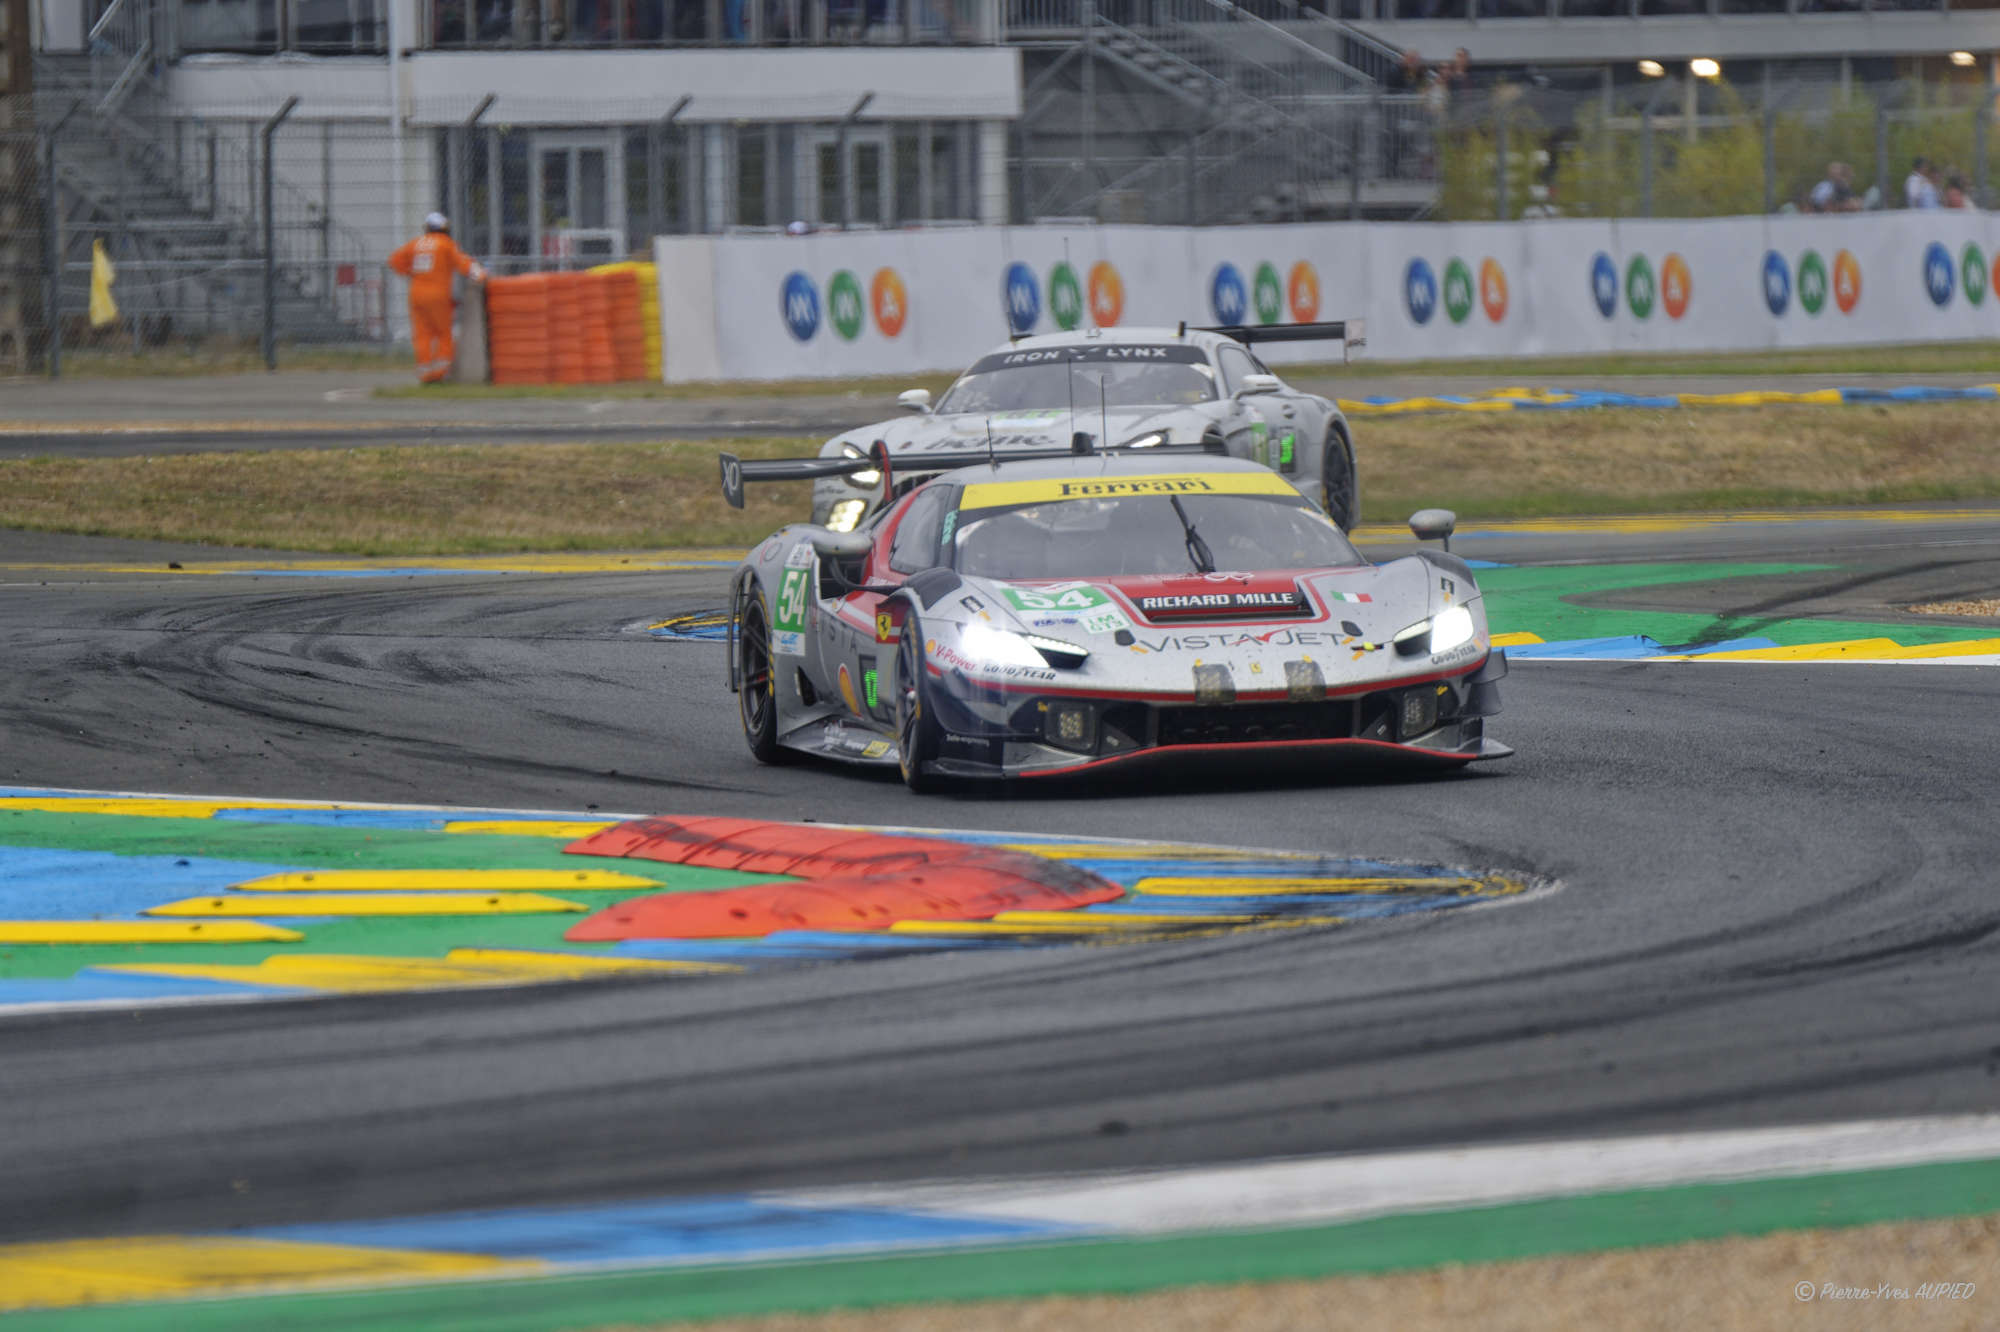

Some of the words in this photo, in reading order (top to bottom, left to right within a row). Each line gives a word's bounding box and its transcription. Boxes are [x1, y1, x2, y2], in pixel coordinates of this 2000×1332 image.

[1003, 350, 1060, 364] IRON
[1105, 347, 1167, 358] LYNX
[1059, 478, 1215, 497] Ferrari
[779, 570, 808, 624] 54
[1015, 589, 1094, 609] 54
[1143, 594, 1231, 609] RICHARD
[1236, 593, 1294, 605] MILLE
[935, 644, 976, 671] V-Power
